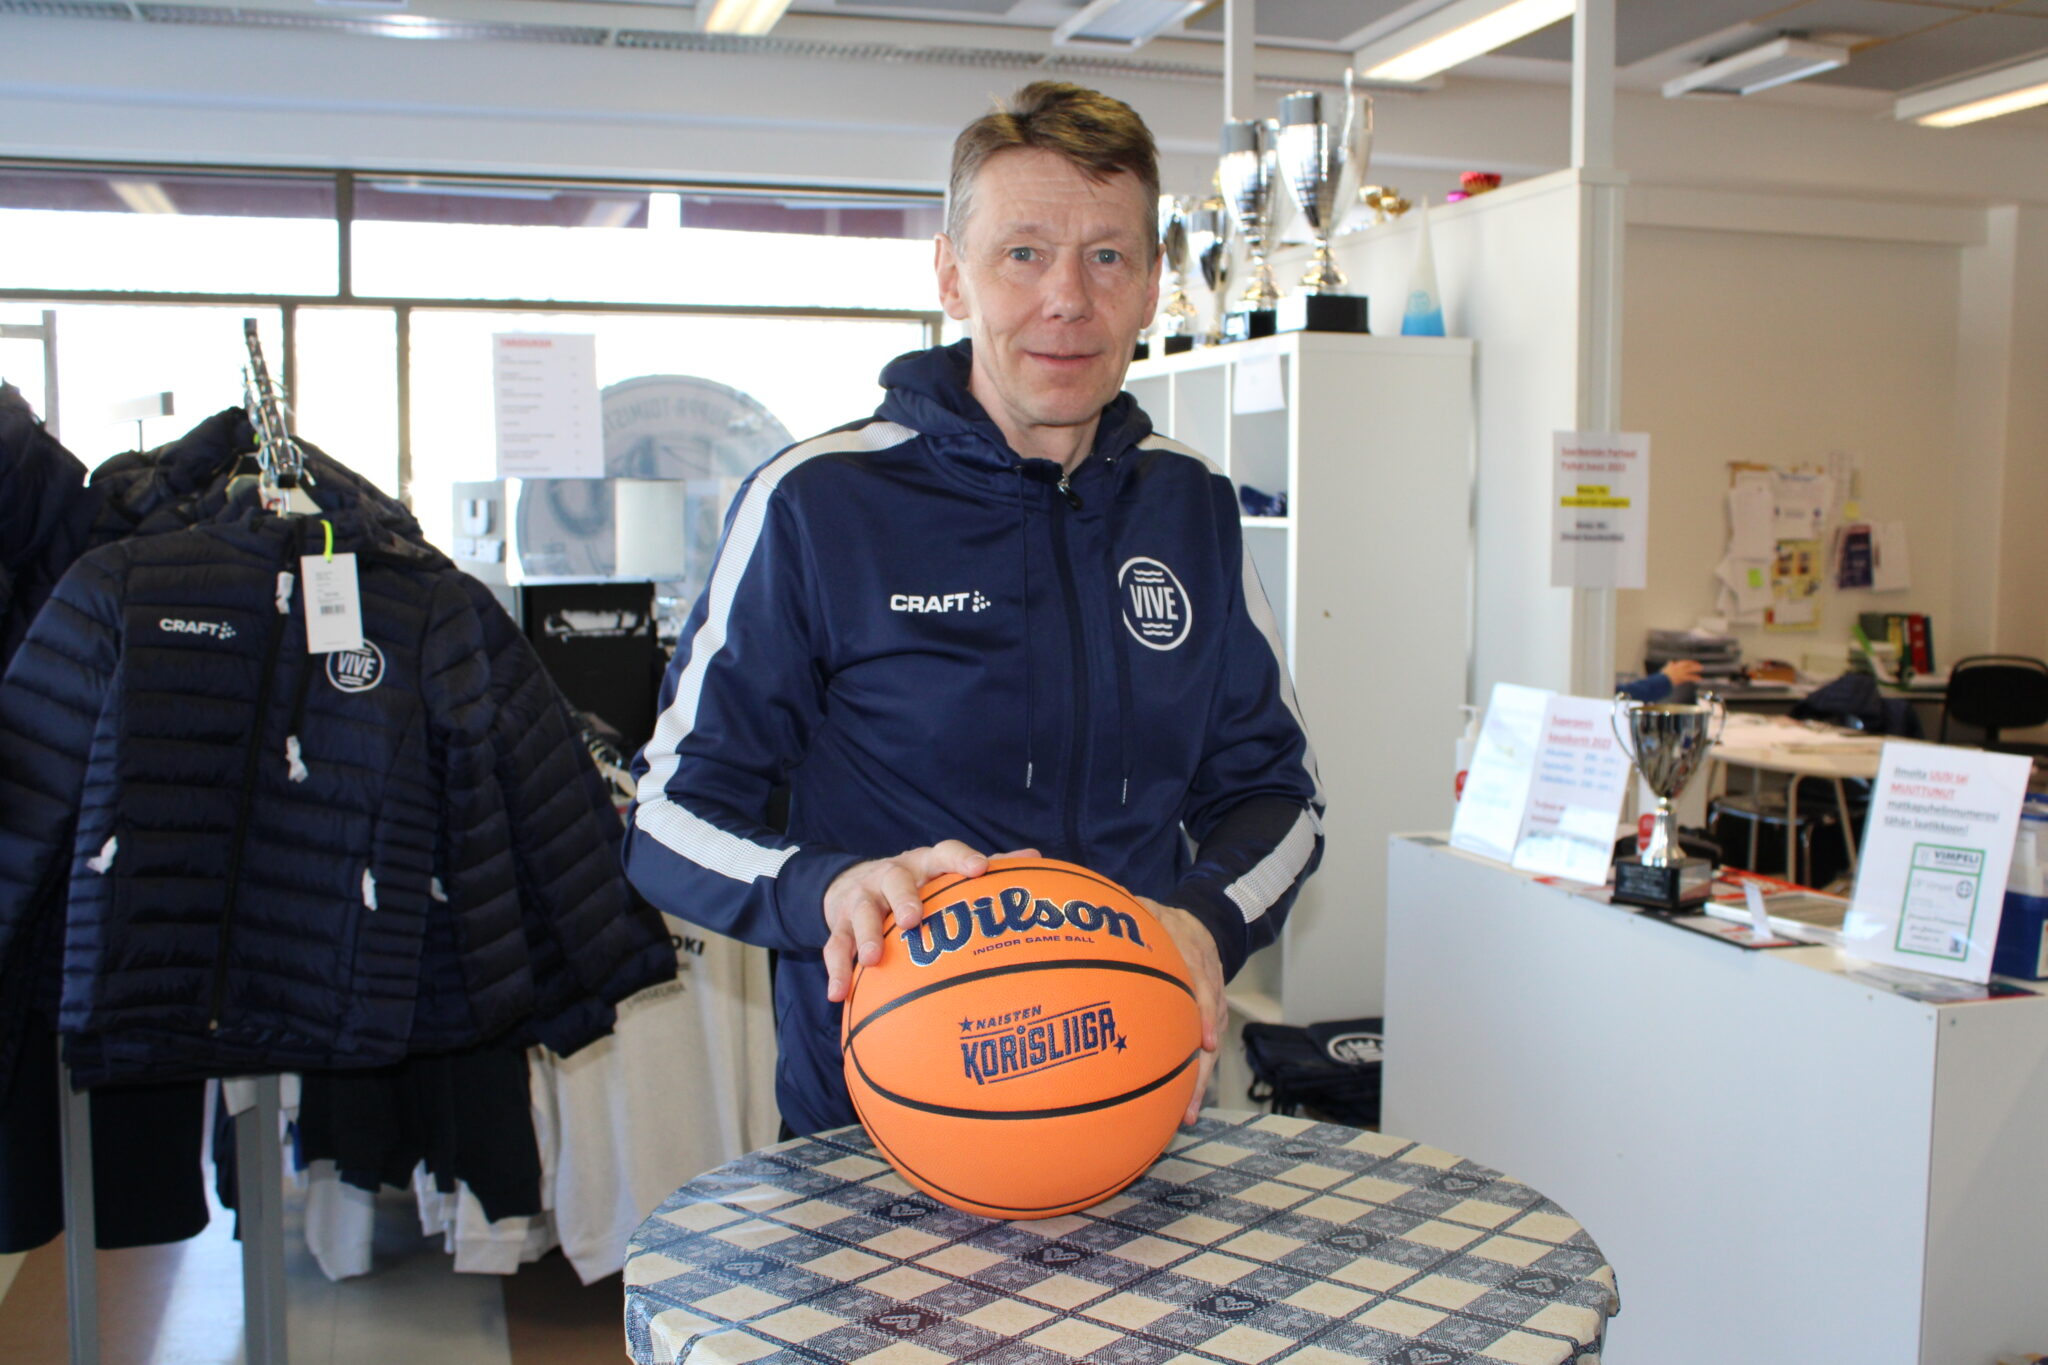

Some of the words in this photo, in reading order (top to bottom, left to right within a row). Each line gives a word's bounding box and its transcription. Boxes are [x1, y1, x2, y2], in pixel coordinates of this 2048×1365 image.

[890, 592, 970, 614] CRAFT
[1129, 583, 1179, 621] VIVE
[159, 618, 220, 637] CRAFT
[338, 651, 377, 680] VIVE
[1934, 850, 1980, 864] VIMPELI
[901, 886, 1146, 967] Wilson
[972, 938, 1021, 956] INDOOR
[1025, 935, 1061, 944] GAME
[1065, 935, 1095, 944] BALL
[976, 1004, 1043, 1030] NAISTEN
